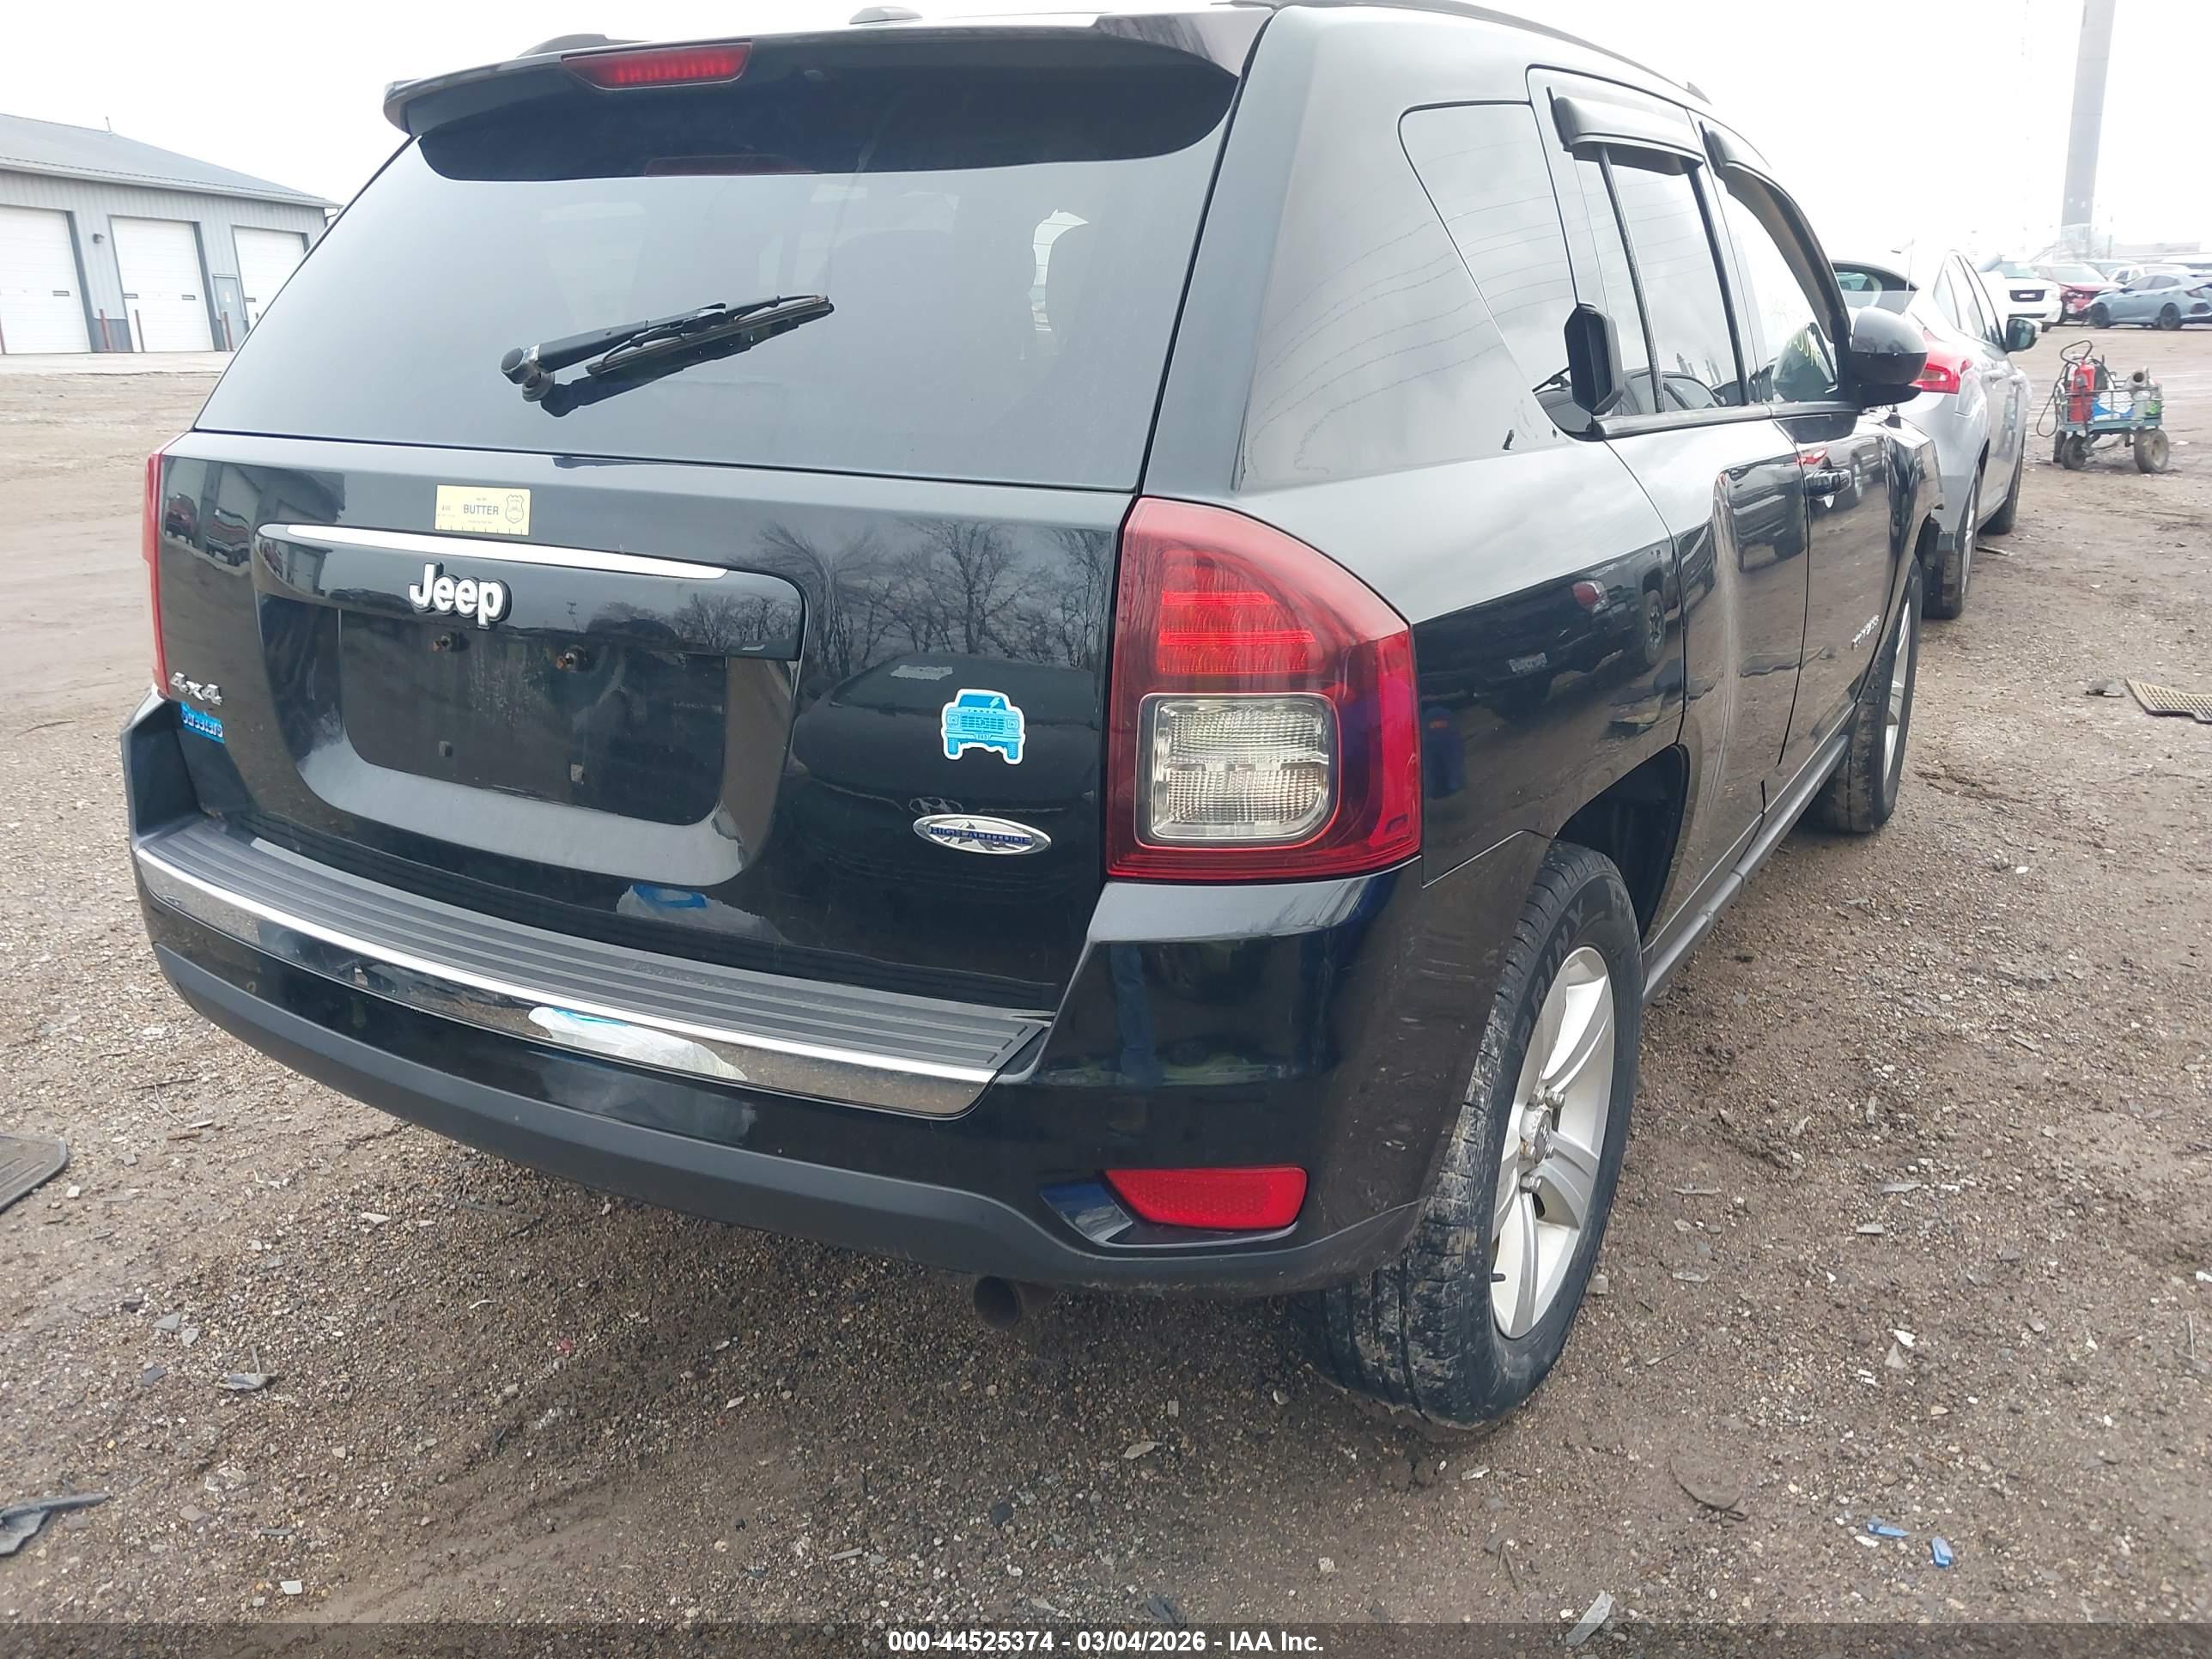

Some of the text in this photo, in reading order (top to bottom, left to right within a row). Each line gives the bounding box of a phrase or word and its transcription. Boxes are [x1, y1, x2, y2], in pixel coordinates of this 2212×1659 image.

[463, 504, 500, 515] BUTTER
[409, 562, 513, 630] Jeep
[170, 672, 223, 706] 4x4
[930, 825, 1031, 845] HIGH ALTITUDE
